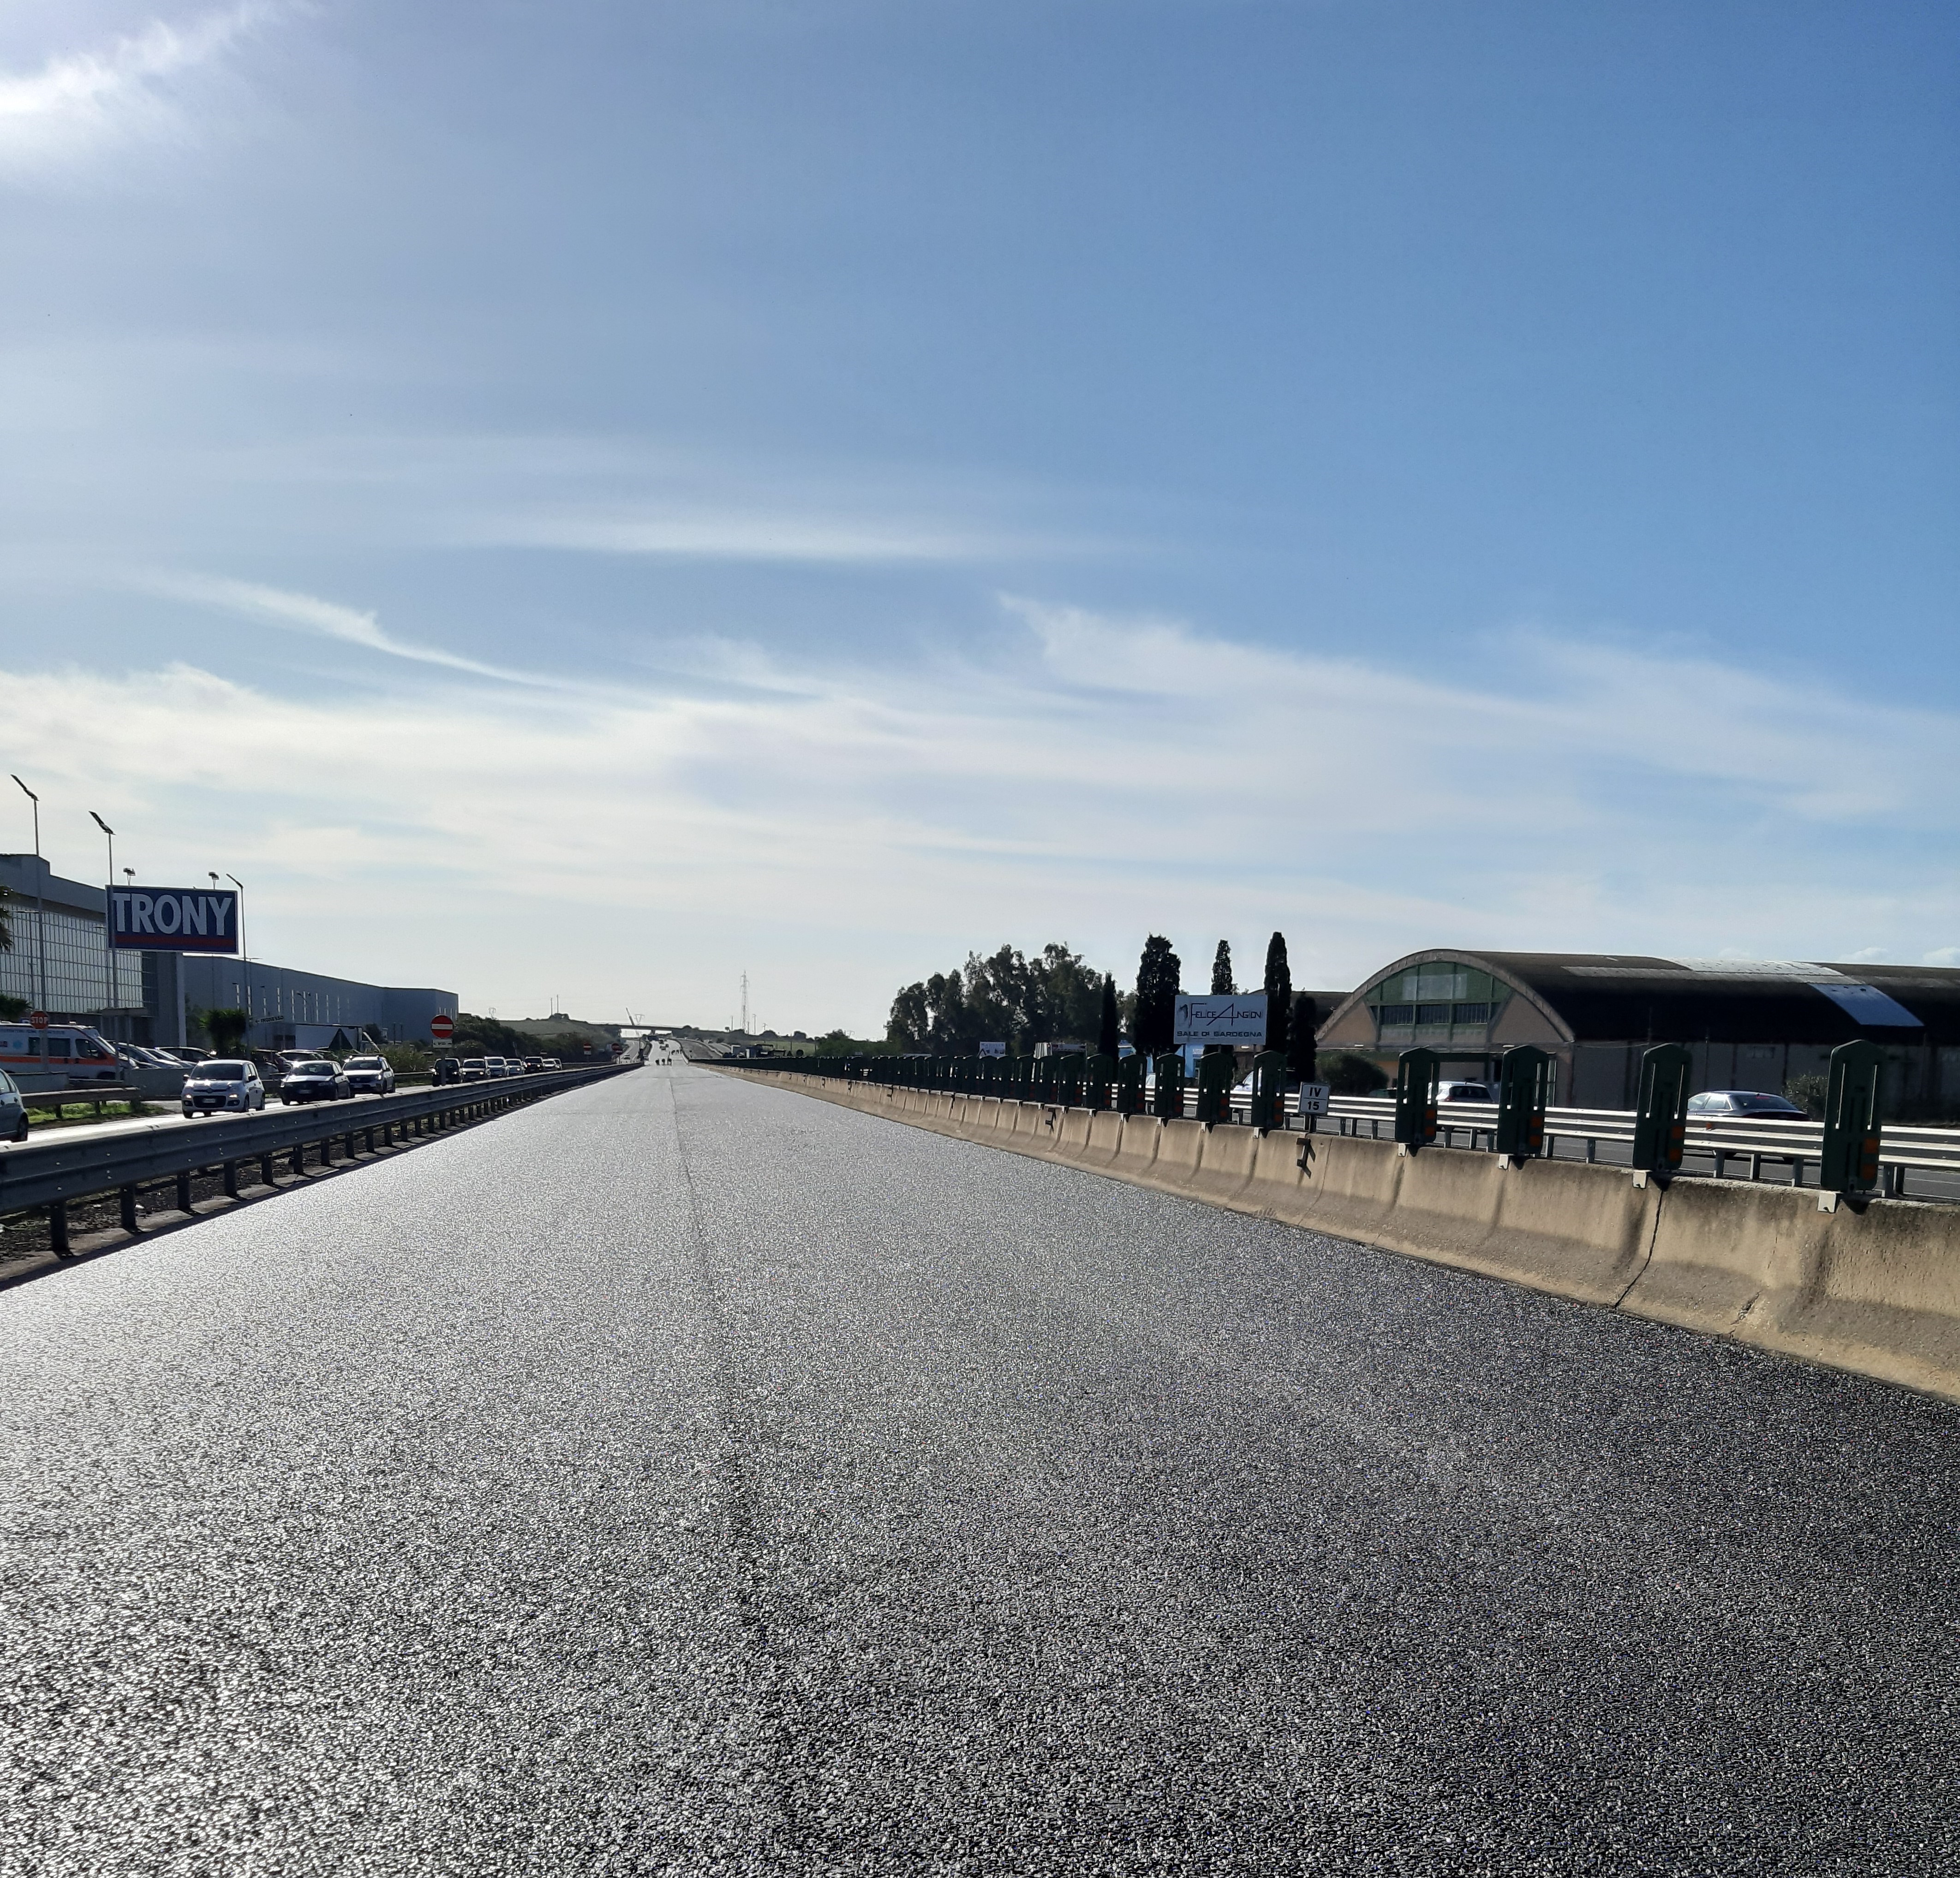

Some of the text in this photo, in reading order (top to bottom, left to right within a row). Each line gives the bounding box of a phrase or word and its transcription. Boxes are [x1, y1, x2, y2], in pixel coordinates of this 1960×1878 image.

[113, 893, 232, 936] TRONY
[1309, 1087, 1321, 1097] IV
[1308, 1101, 1320, 1110] 15
